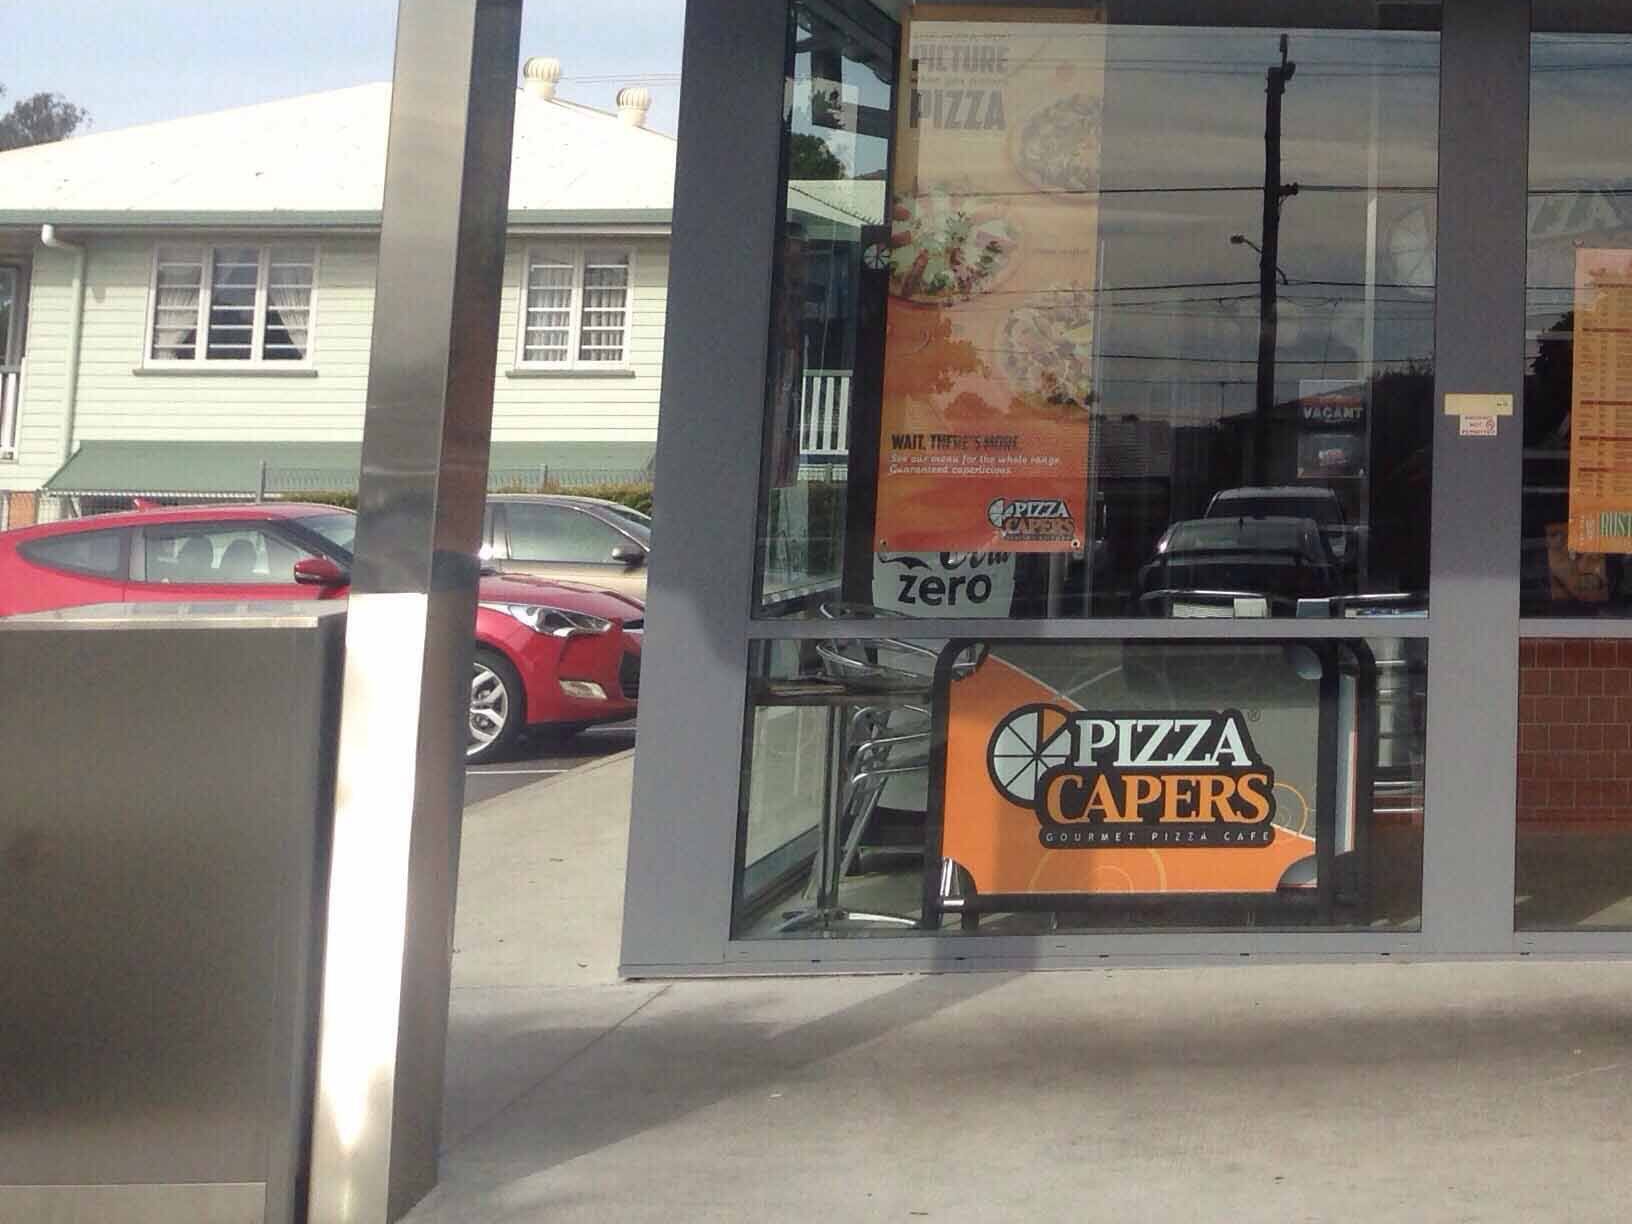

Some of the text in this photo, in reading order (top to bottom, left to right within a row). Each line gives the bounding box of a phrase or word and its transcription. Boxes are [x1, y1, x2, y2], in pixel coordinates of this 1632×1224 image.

[1013, 501, 1070, 518] PIZZA
[898, 574, 992, 606] zero
[1072, 716, 1253, 767] PIZZA
[1045, 773, 1271, 824] CAPERS
[1046, 831, 1270, 842] GOURMET PIZZA CAFE
